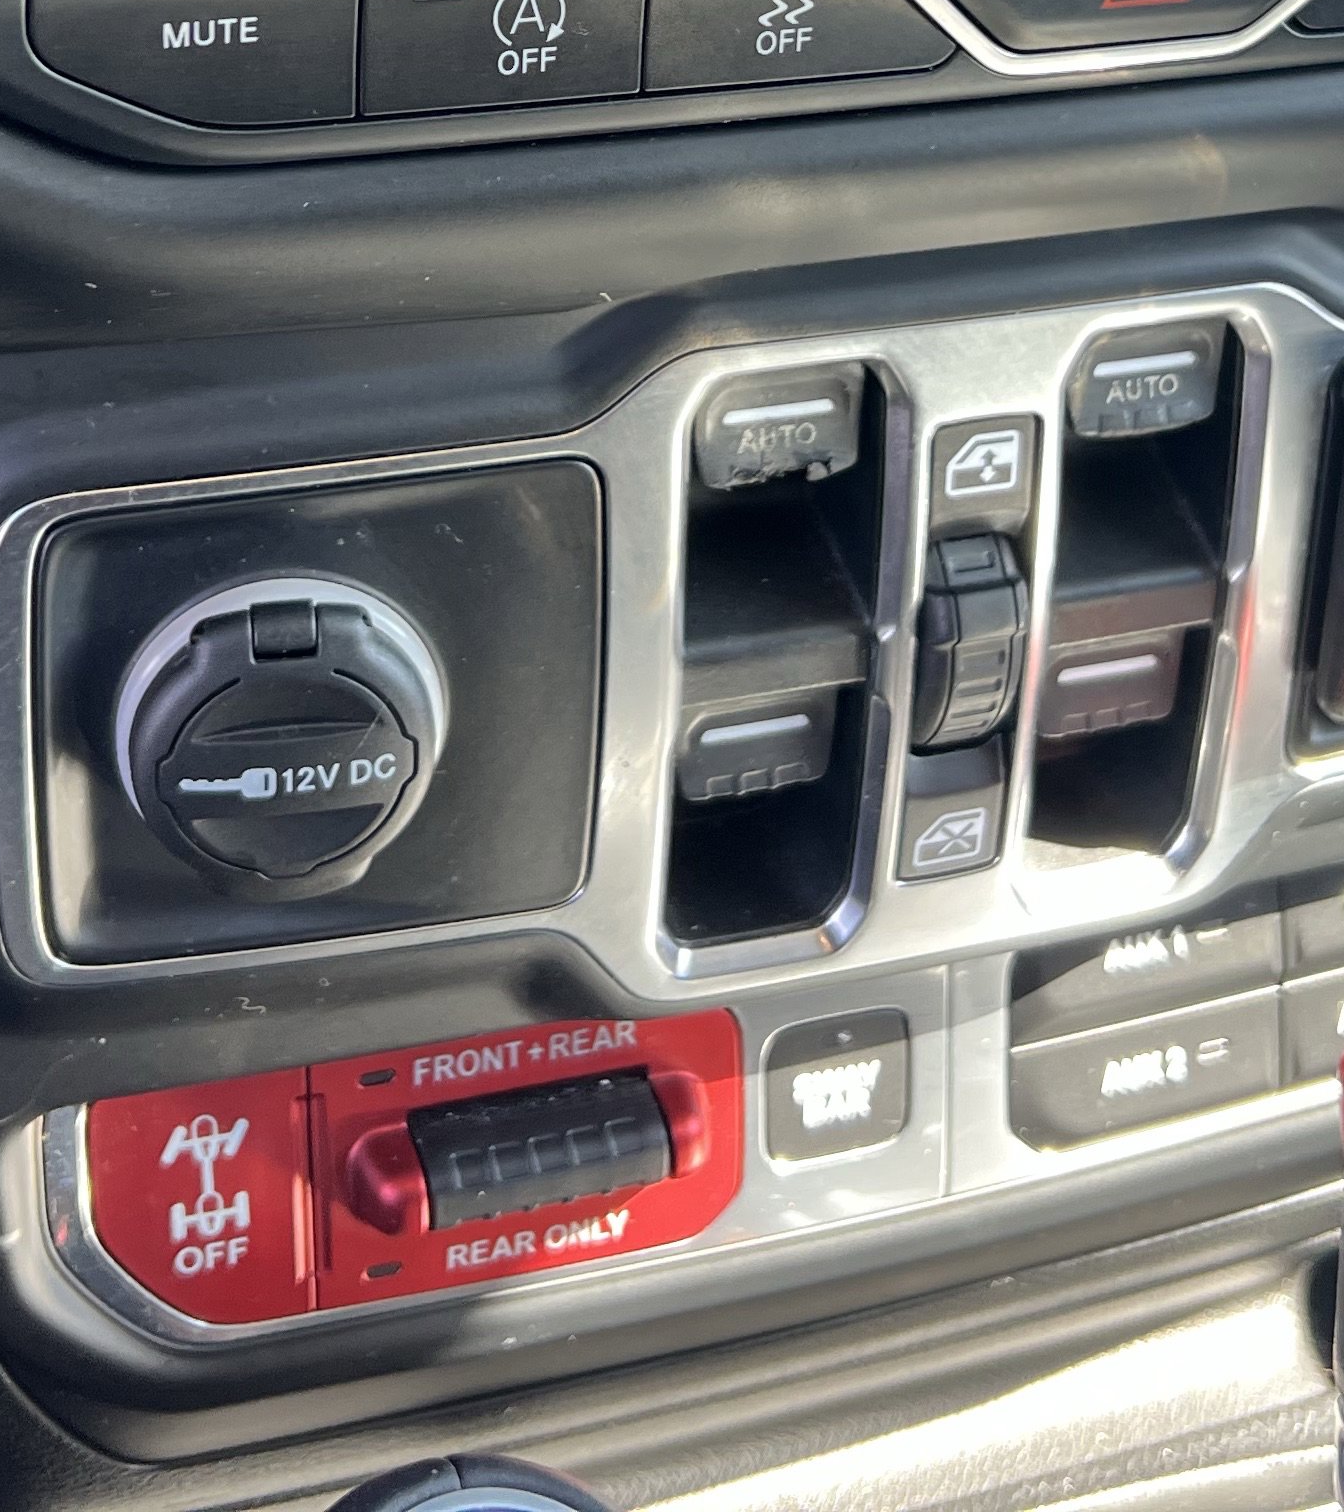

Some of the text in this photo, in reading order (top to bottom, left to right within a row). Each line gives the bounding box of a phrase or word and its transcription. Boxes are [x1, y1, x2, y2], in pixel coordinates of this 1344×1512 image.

[162, 16, 259, 49] MUTE
[755, 24, 813, 56] OFF
[497, 46, 558, 76] OFF
[1106, 371, 1180, 405] AUTO
[738, 420, 817, 455] AUTO
[281, 752, 398, 793] 12V DC
[173, 1235, 249, 1276] OFF
[445, 1208, 630, 1270] REAR ONLY
